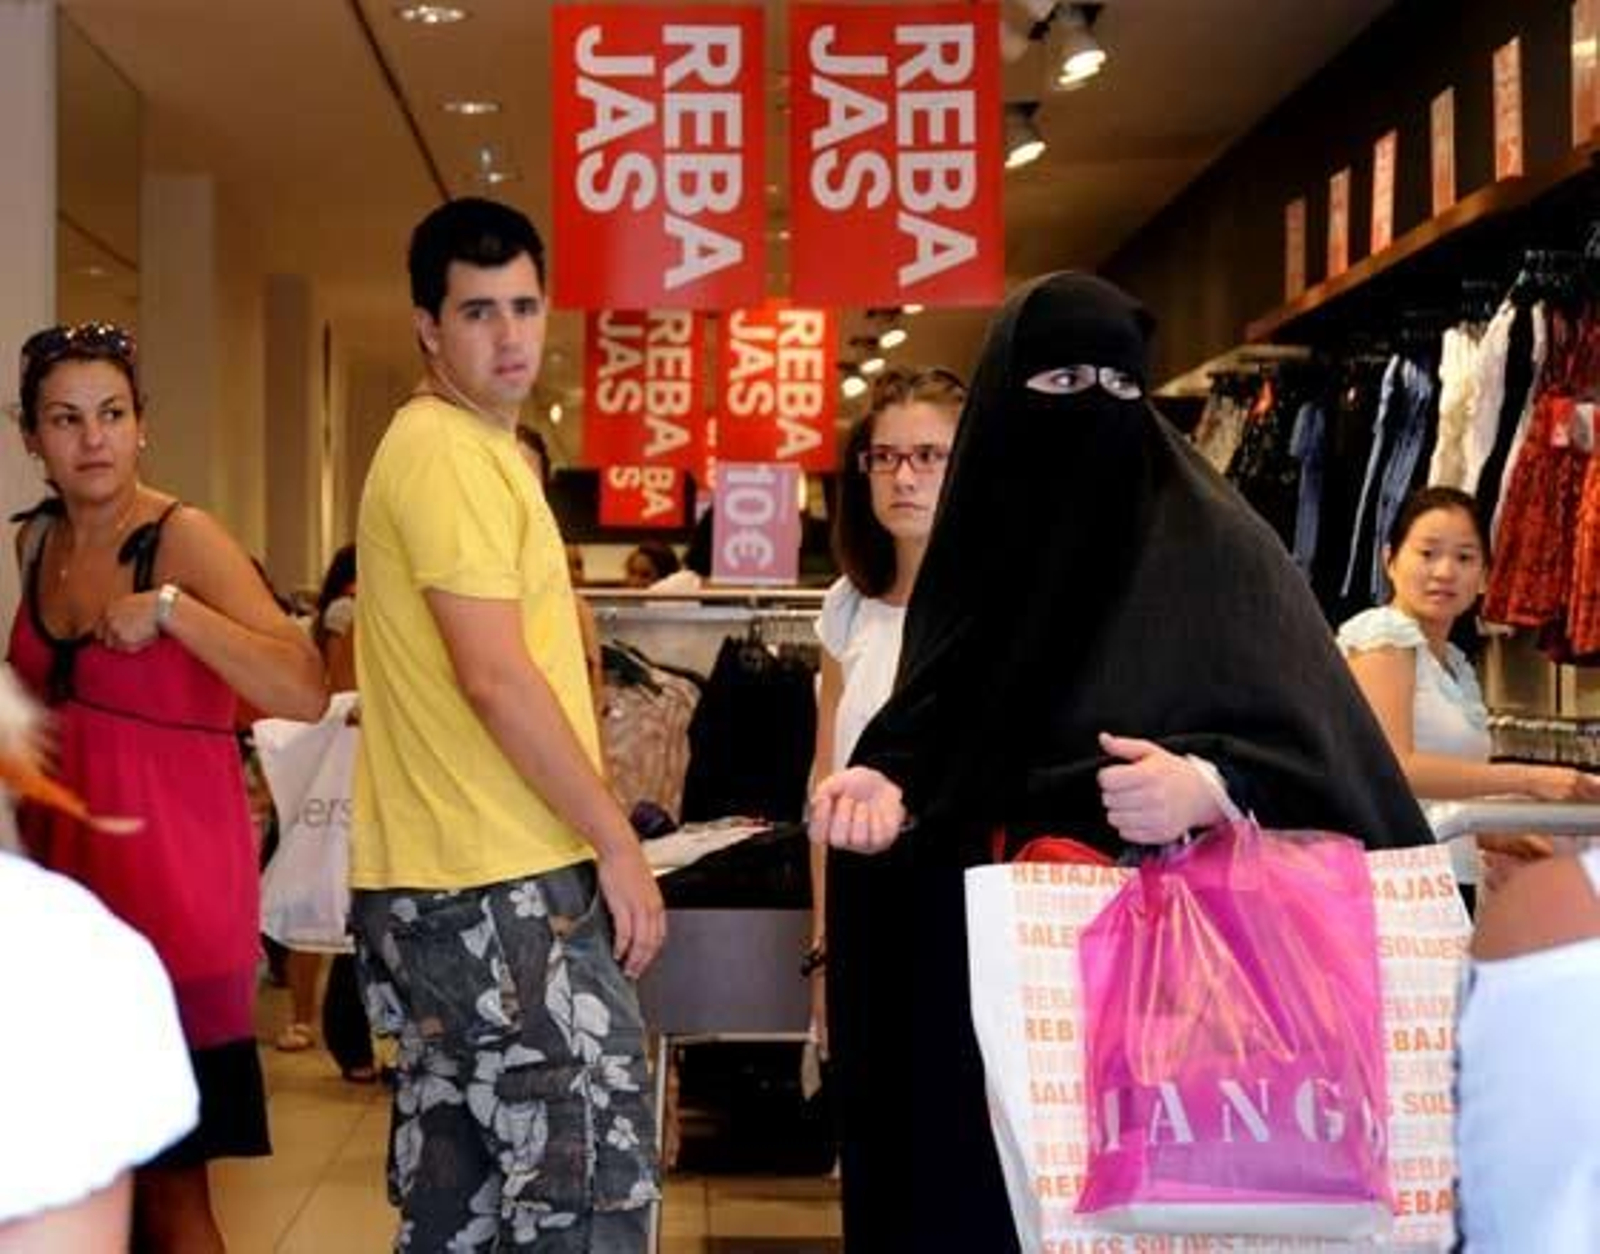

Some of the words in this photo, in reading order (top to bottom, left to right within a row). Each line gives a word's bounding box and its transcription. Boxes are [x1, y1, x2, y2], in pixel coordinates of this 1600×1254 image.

[574, 25, 658, 213] JAS
[662, 24, 744, 291] REBA
[809, 25, 892, 212] JAS
[895, 23, 979, 288] REBA
[595, 309, 643, 414] JAS
[645, 309, 693, 458] REBA
[727, 309, 776, 417] JAS
[776, 309, 825, 460] REBA
[723, 469, 776, 569] 10€
